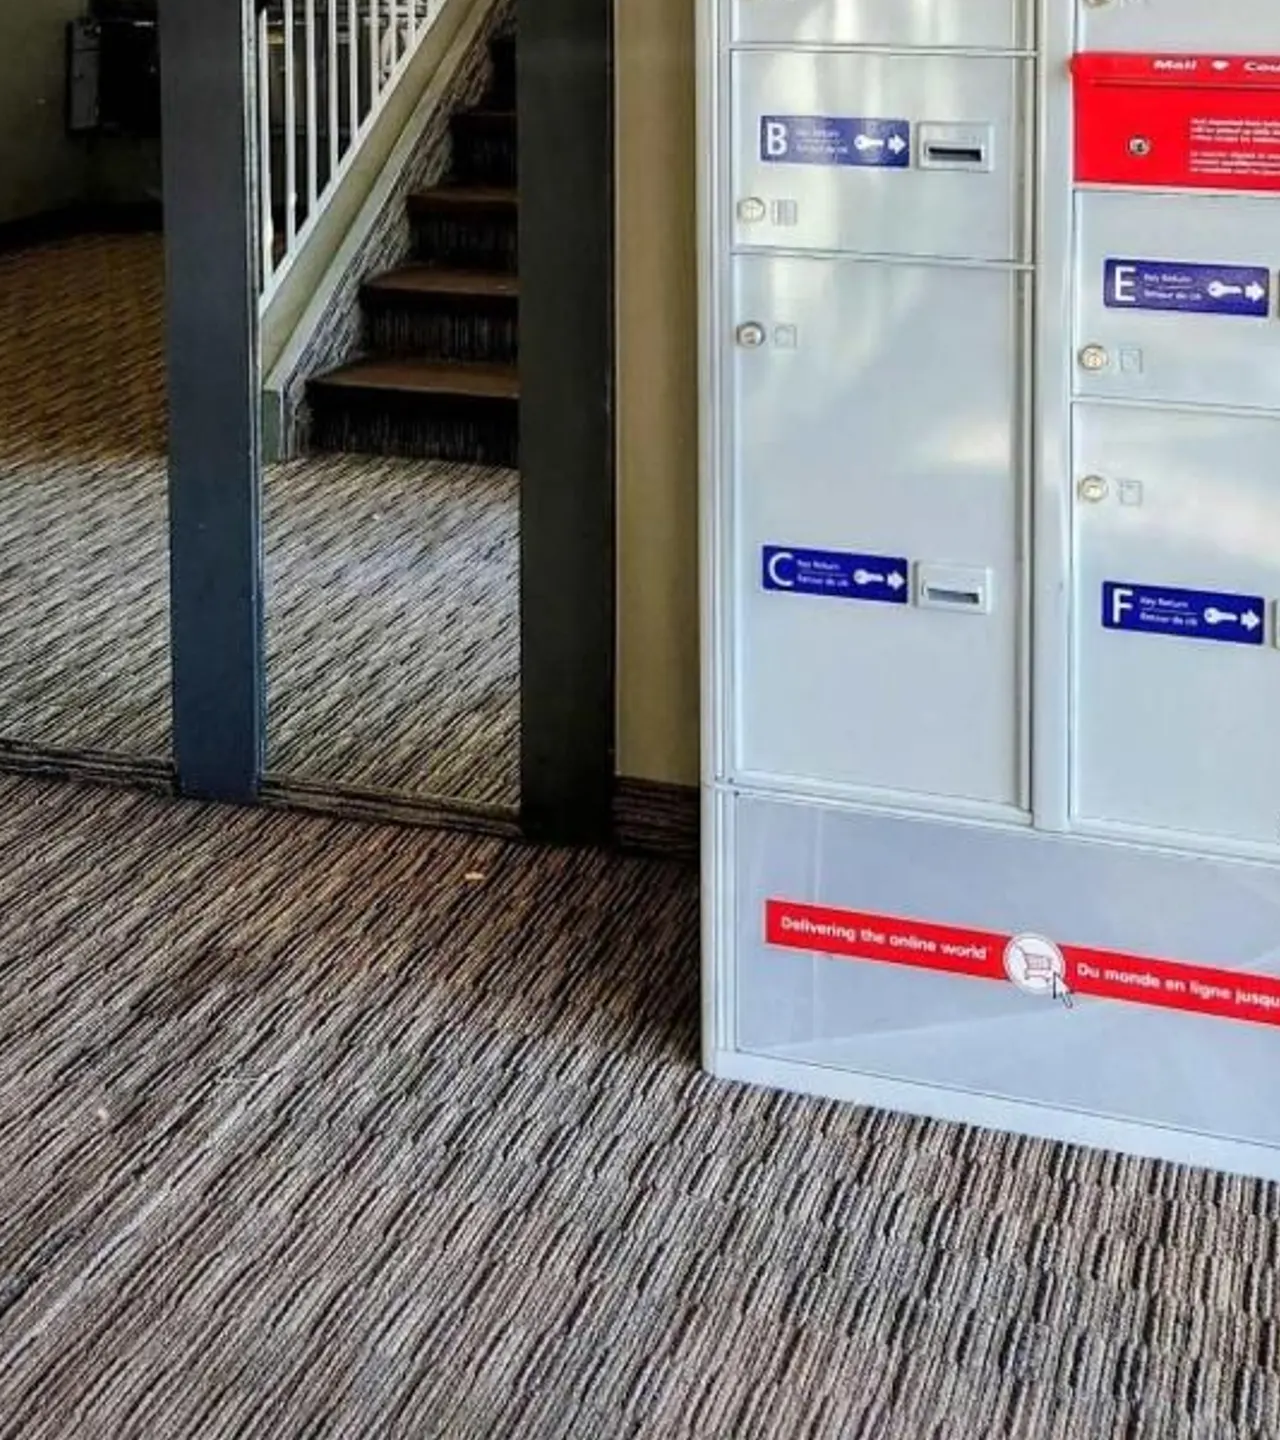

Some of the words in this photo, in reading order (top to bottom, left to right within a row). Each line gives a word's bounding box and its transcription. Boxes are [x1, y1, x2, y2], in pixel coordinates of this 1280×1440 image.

[1154, 60, 1198, 71] Mail
[766, 122, 788, 155] B
[1115, 266, 1136, 301] E
[768, 551, 795, 588] C
[1113, 588, 1133, 624] F
[780, 916, 855, 942] Delivering
[860, 929, 886, 945] the
[889, 933, 936, 953] online
[940, 941, 988, 961] world
[1076, 962, 1100, 979] Du
[1104, 970, 1160, 989] monde
[1165, 978, 1186, 993] en
[1189, 980, 1231, 1002] ligne
